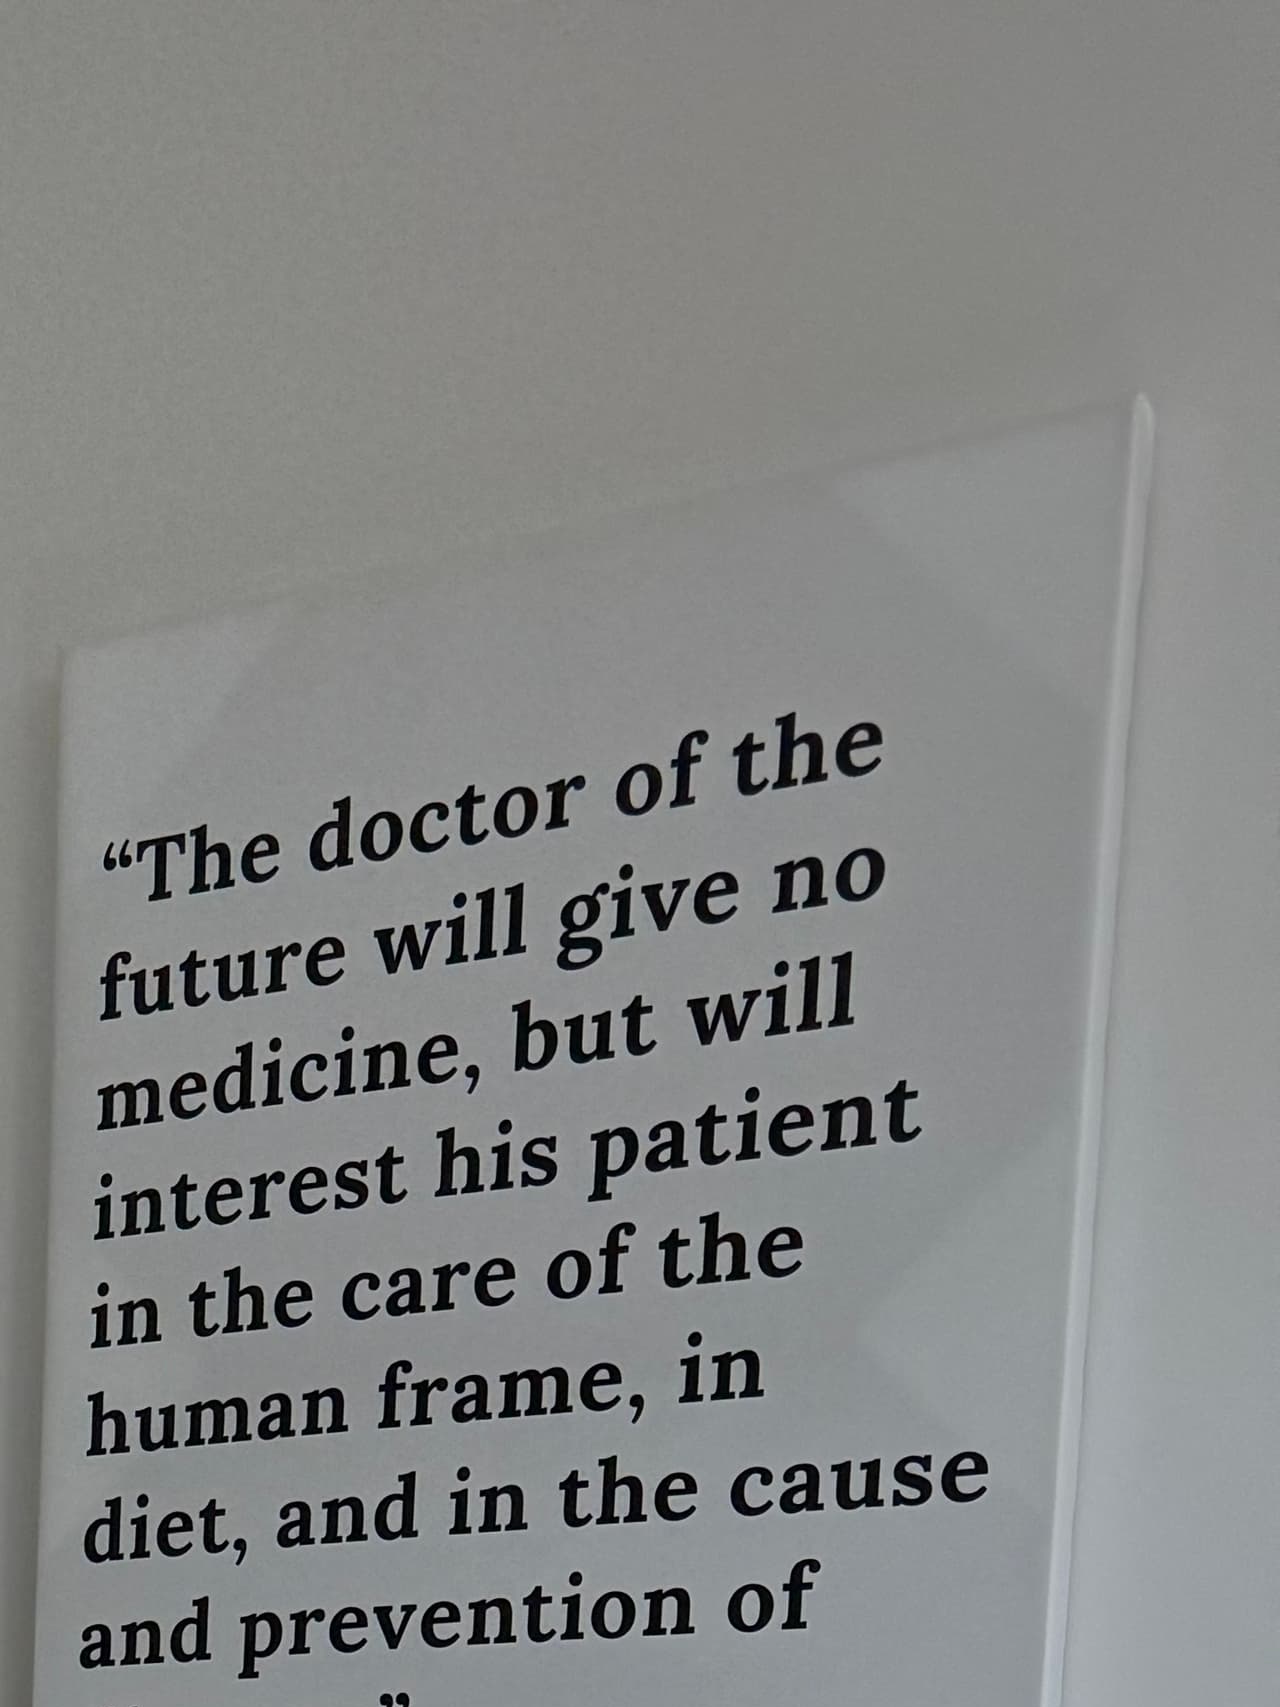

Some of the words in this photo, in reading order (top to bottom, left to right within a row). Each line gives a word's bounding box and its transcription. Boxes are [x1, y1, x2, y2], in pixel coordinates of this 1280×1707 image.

[103, 823, 280, 902] “The
[309, 774, 586, 872] doctor
[615, 729, 710, 817] of
[732, 711, 883, 796] the
[99, 936, 346, 1022] future
[373, 882, 527, 975] will
[556, 863, 739, 971] give
[771, 847, 886, 914] no
[96, 1025, 480, 1131] medicine,
[511, 994, 658, 1072] but
[686, 950, 855, 1046] will
[93, 1145, 409, 1241] interest
[434, 1118, 558, 1198] his
[587, 1079, 923, 1203] patient
[90, 1281, 163, 1349] in
[188, 1265, 314, 1338] the
[341, 1257, 516, 1321] care
[546, 1221, 637, 1300] of
[658, 1211, 804, 1289] the
[86, 1387, 349, 1457] human
[377, 1359, 645, 1430] frame,
[678, 1331, 765, 1404] in
[83, 1493, 247, 1567] diet,
[276, 1470, 419, 1549] and
[448, 1466, 529, 1536] in
[558, 1454, 698, 1528] the
[730, 1451, 989, 1517] cause
[79, 1595, 212, 1670] and
[237, 1571, 696, 1680] prevention
[727, 1558, 822, 1633] of
